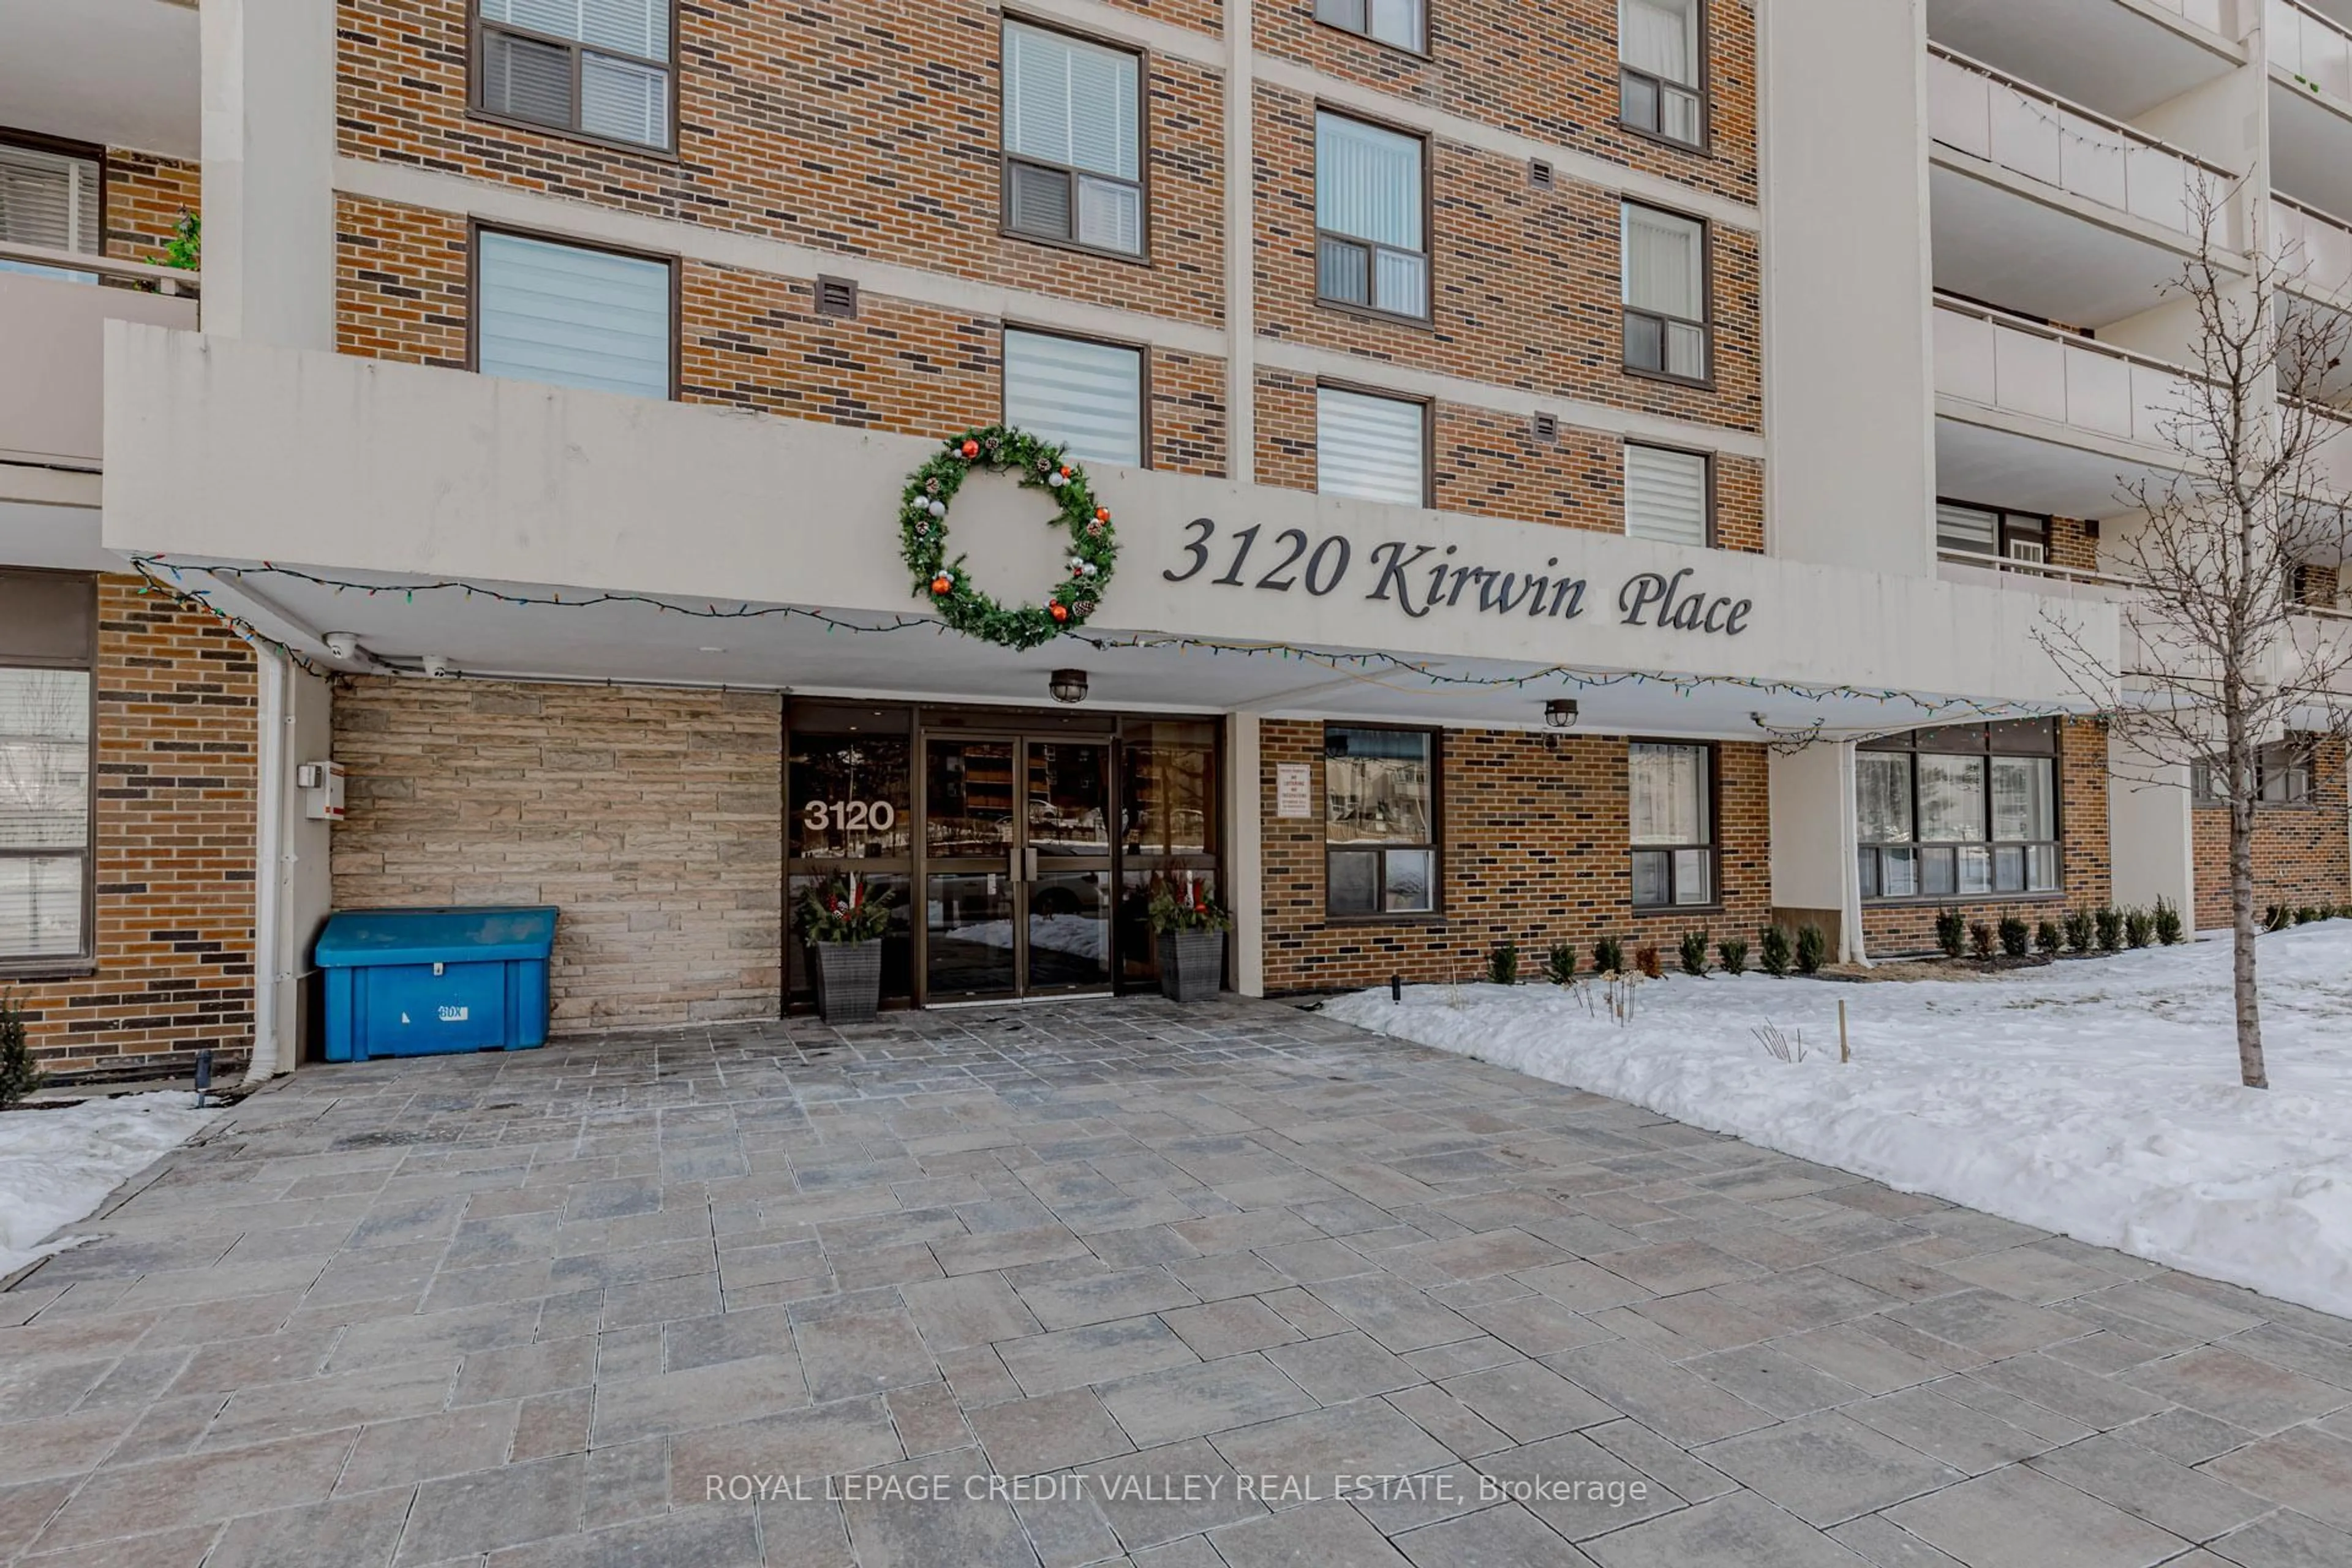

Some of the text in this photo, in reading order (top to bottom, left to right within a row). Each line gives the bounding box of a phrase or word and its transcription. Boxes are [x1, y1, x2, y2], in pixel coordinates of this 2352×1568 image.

[1163, 518, 1752, 636] 3120 Kirwin Place
[805, 801, 894, 831] 3120
